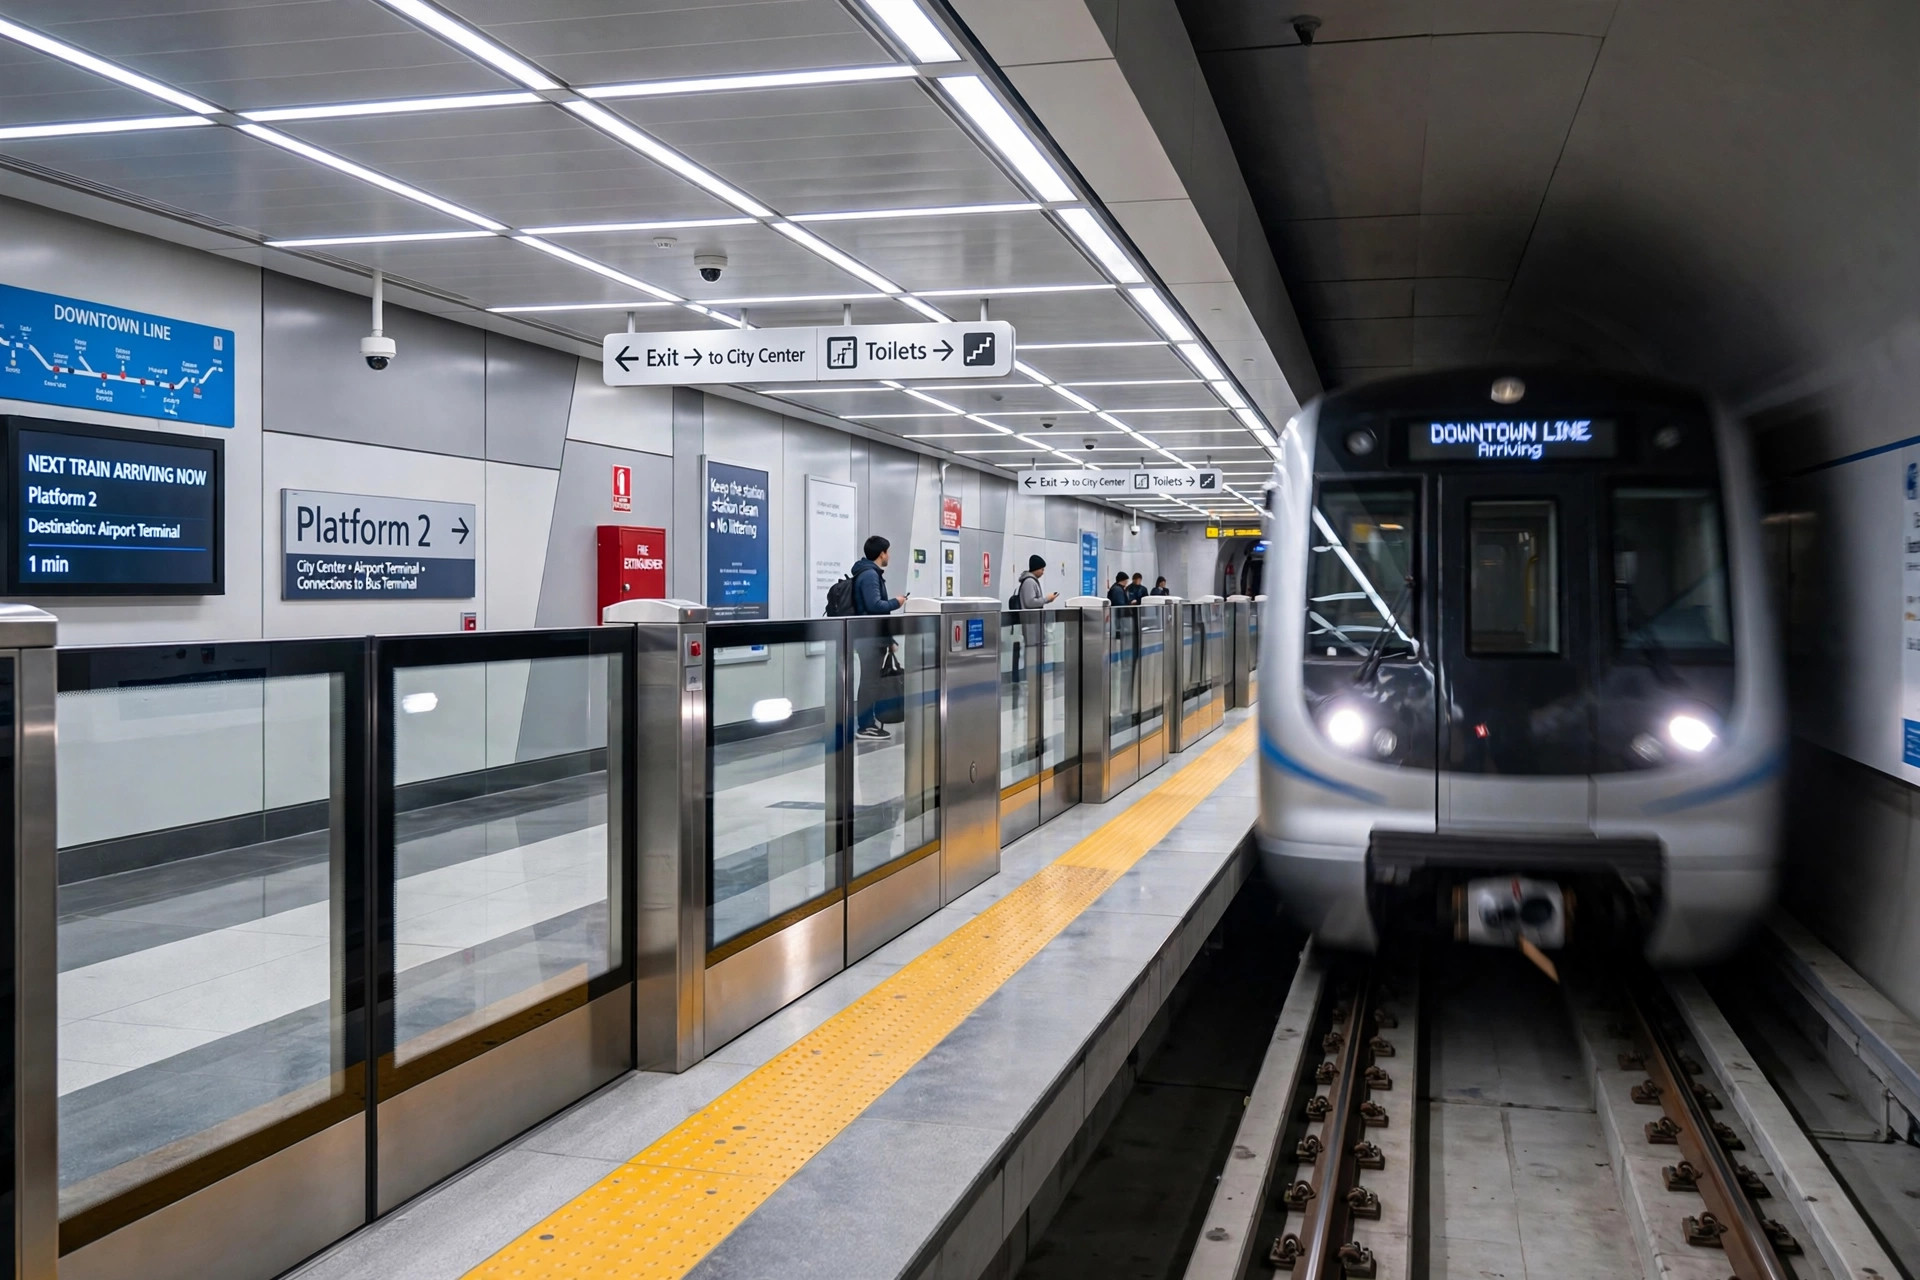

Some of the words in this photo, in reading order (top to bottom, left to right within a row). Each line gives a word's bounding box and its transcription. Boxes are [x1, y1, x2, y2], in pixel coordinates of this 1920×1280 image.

[54, 304, 140, 335] DOWNTOWN
[143, 321, 172, 341] LINE
[647, 348, 679, 367] Exit
[708, 351, 724, 365] to
[727, 349, 756, 368] City
[758, 347, 805, 364] Center
[865, 341, 927, 361] Toilets
[1431, 421, 1536, 444] DOWNTOWN
[1543, 420, 1592, 442] LINE
[1478, 440, 1543, 461] Arriving
[28, 454, 66, 474] NEXT
[69, 458, 111, 478] TRAIN
[113, 462, 174, 483] ARRIVING
[176, 468, 207, 486] NOW
[1153, 475, 1183, 486] Toilets
[710, 477, 729, 498] Keep
[730, 480, 742, 496] the
[1040, 477, 1057, 487] Exit
[1072, 478, 1080, 486] to
[1081, 478, 1098, 489] City
[1099, 477, 1125, 487] Center
[28, 486, 86, 506] Platform
[88, 491, 97, 507] 2
[28, 518, 96, 536] Destination:
[98, 521, 136, 540] Airport
[137, 523, 180, 539] Terminal
[297, 505, 410, 547] Platform
[417, 514, 431, 547] 2
[716, 517, 728, 534] No
[28, 555, 36, 572] 1
[41, 555, 69, 572] min
[296, 559, 315, 576] City
[316, 560, 347, 574] Center
[353, 561, 385, 579] Airport
[385, 562, 420, 575] Terminal
[296, 576, 353, 591] Connections
[354, 577, 364, 590] to
[365, 577, 382, 590] Bus
[382, 576, 418, 590] Terminal
